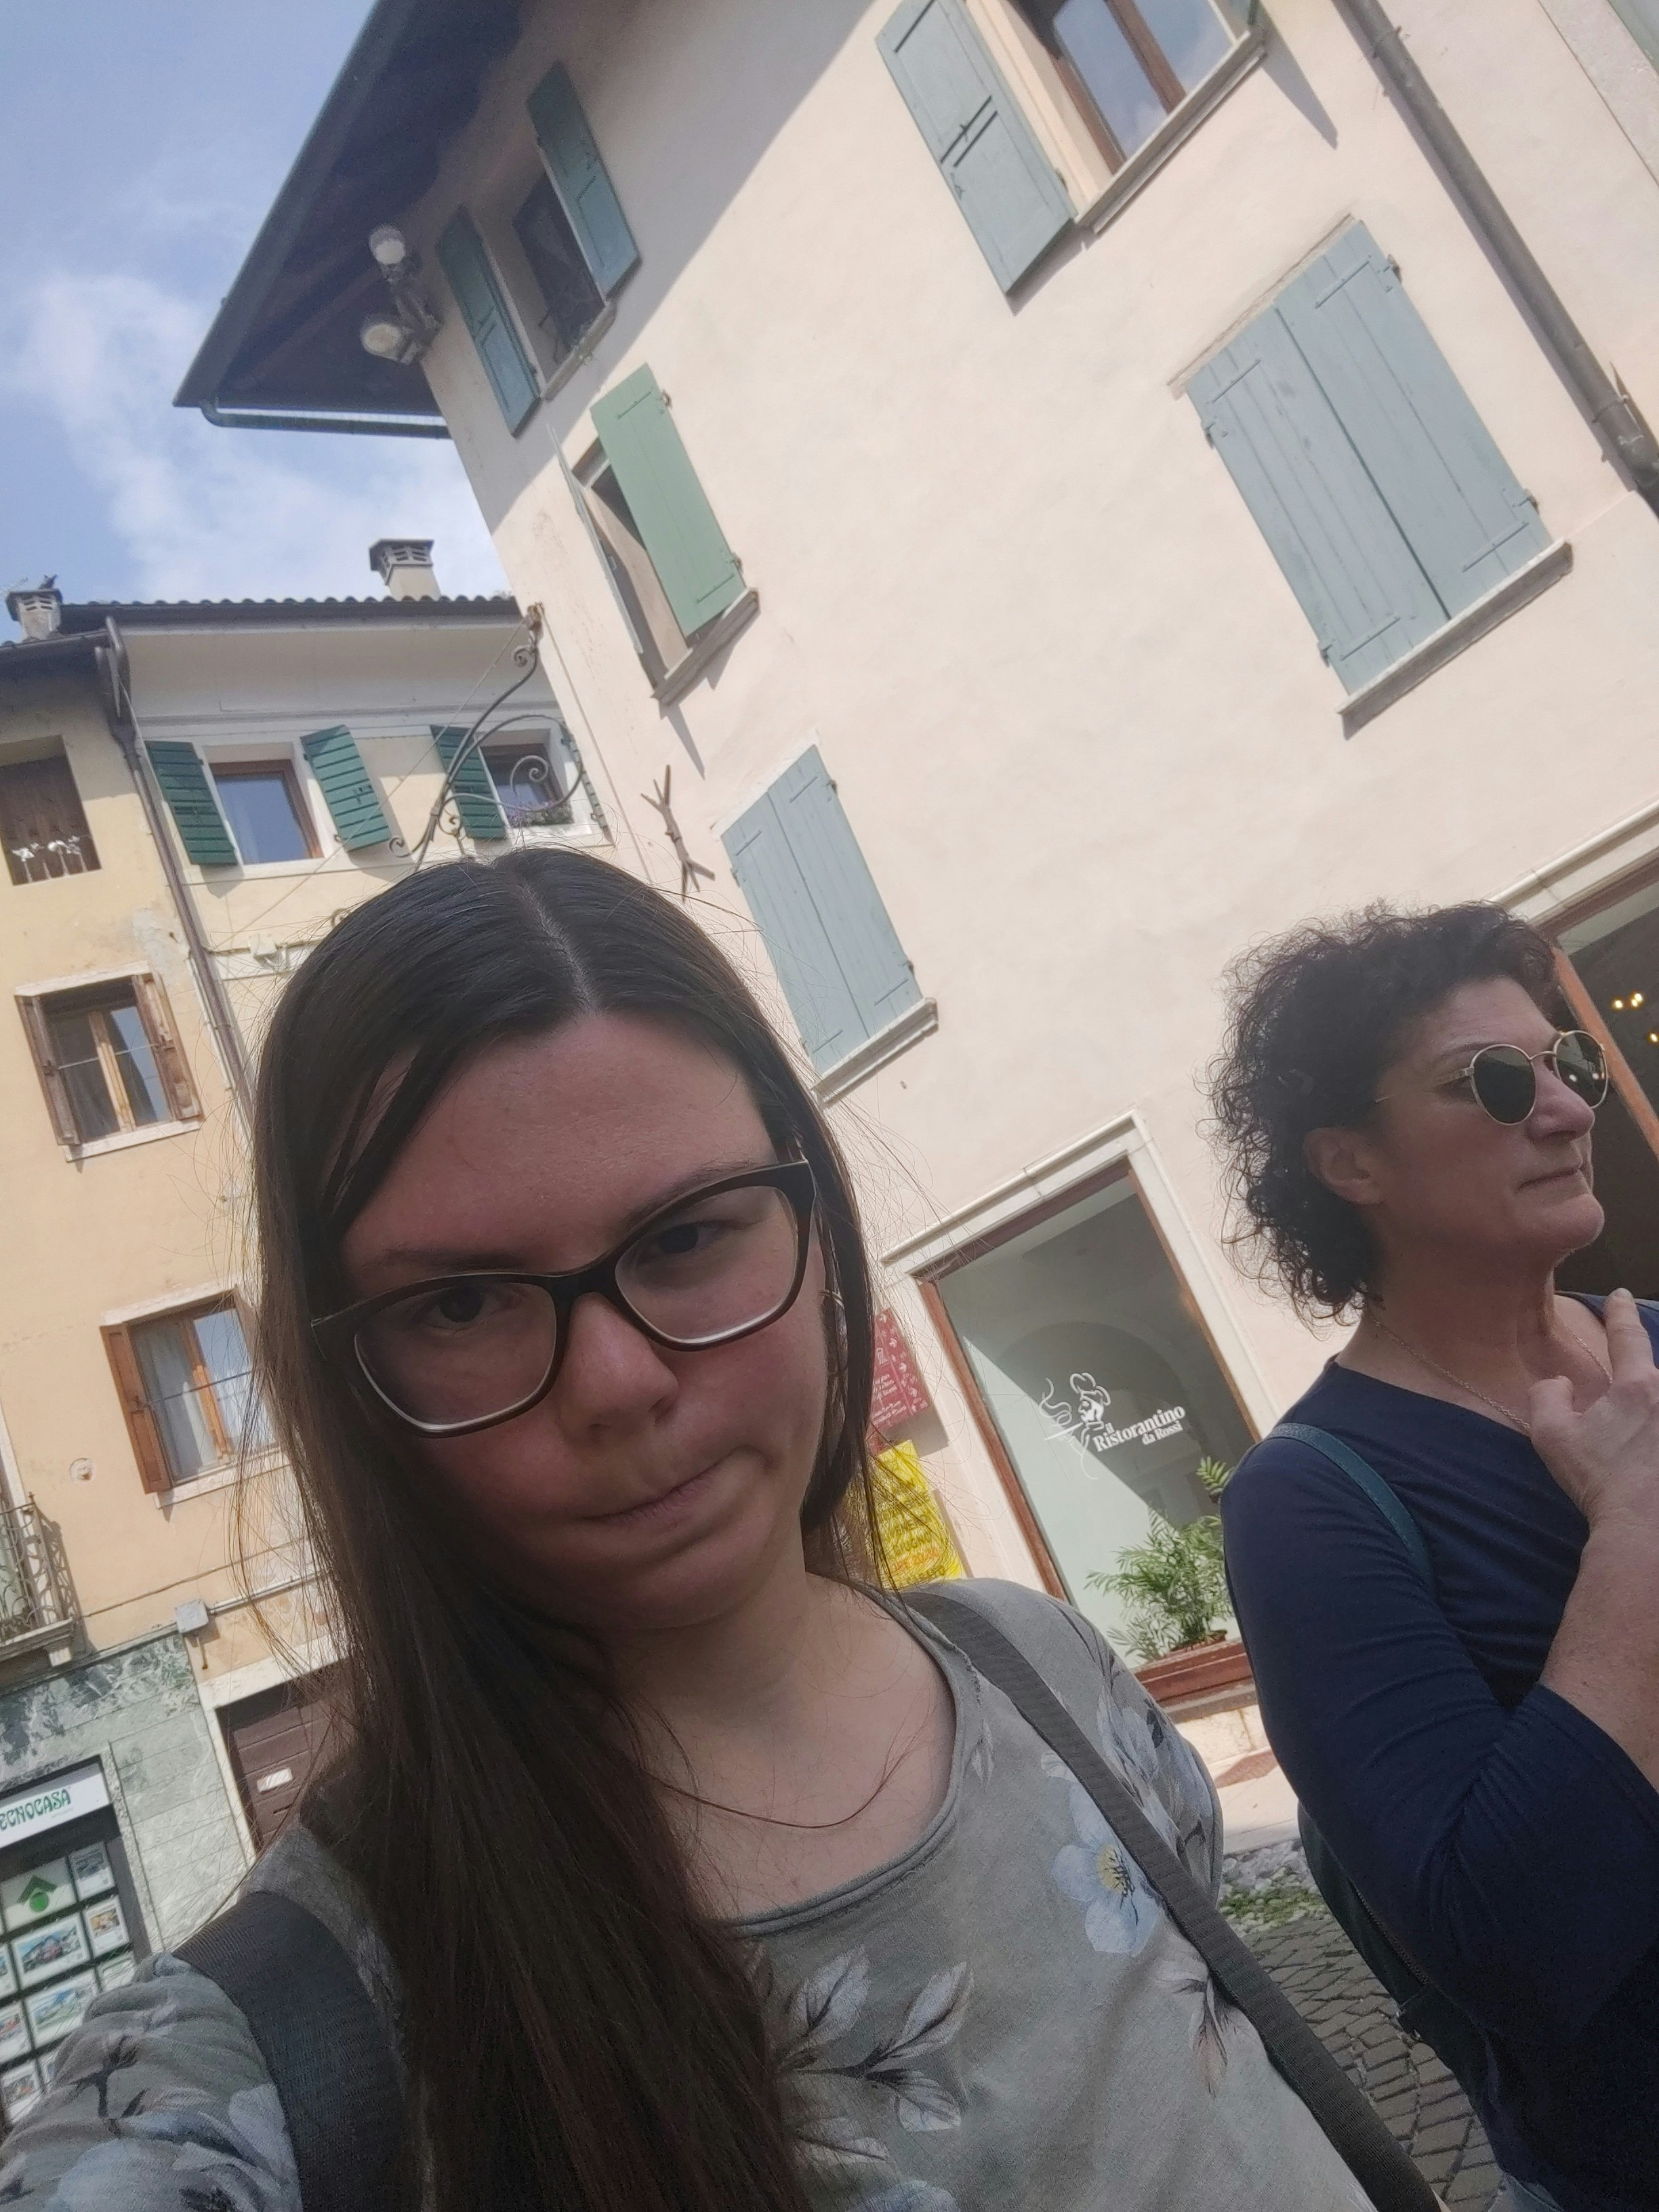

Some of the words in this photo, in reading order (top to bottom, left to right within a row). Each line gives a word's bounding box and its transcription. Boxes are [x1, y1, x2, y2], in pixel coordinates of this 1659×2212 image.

[1092, 1406, 1186, 1452] Ristorantino
[1141, 1432, 1156, 1446] da
[1154, 1420, 1183, 1440] Rossi
[0, 1788, 71, 1830] ECNOCASA
